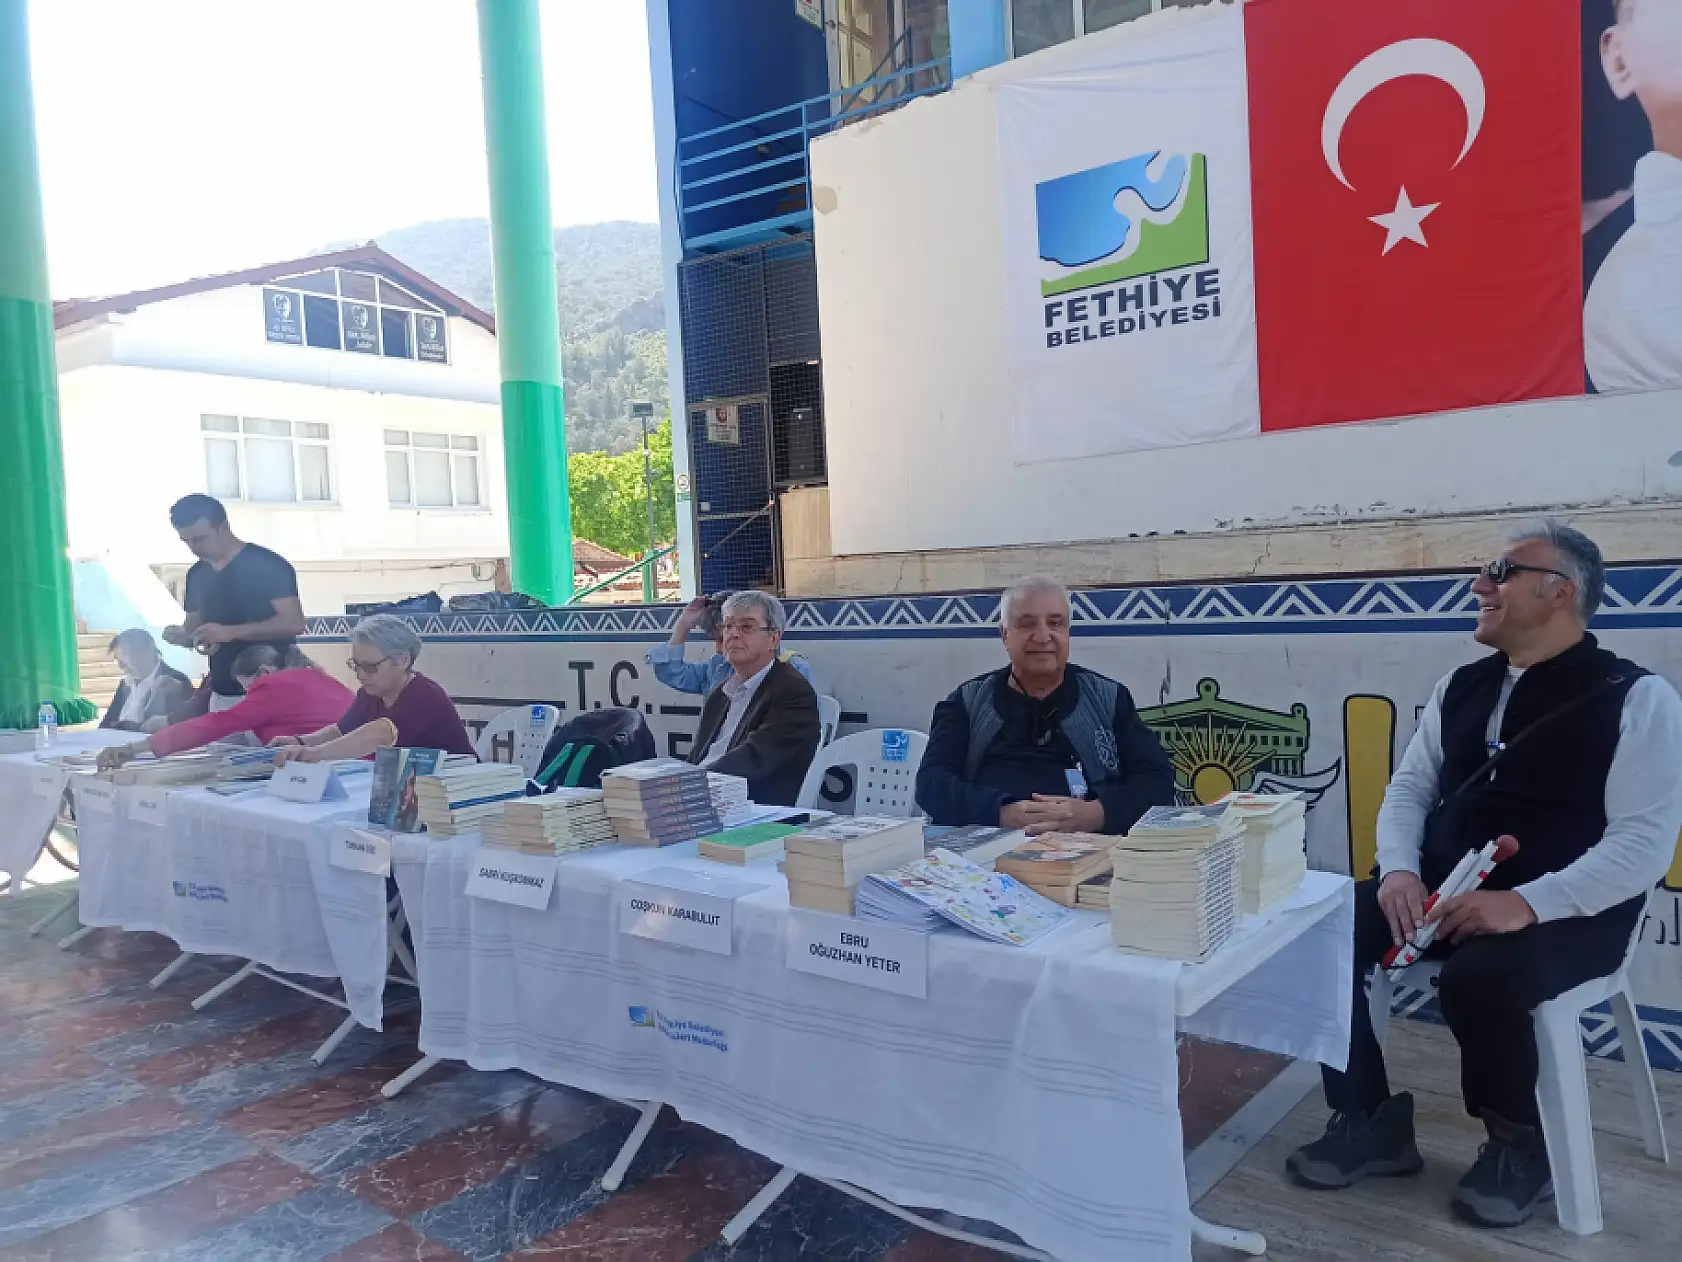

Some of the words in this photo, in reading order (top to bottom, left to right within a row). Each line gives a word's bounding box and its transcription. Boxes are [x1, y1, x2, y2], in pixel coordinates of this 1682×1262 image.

[1044, 268, 1221, 328] FETHİYE
[1046, 295, 1221, 349] BELEDİYESİ
[568, 660, 652, 715] T.C.
[667, 905, 721, 927] KARABULUT
[809, 941, 862, 966] OĞUZHAN
[864, 954, 901, 974] YETER
[840, 931, 870, 949] EBRU
